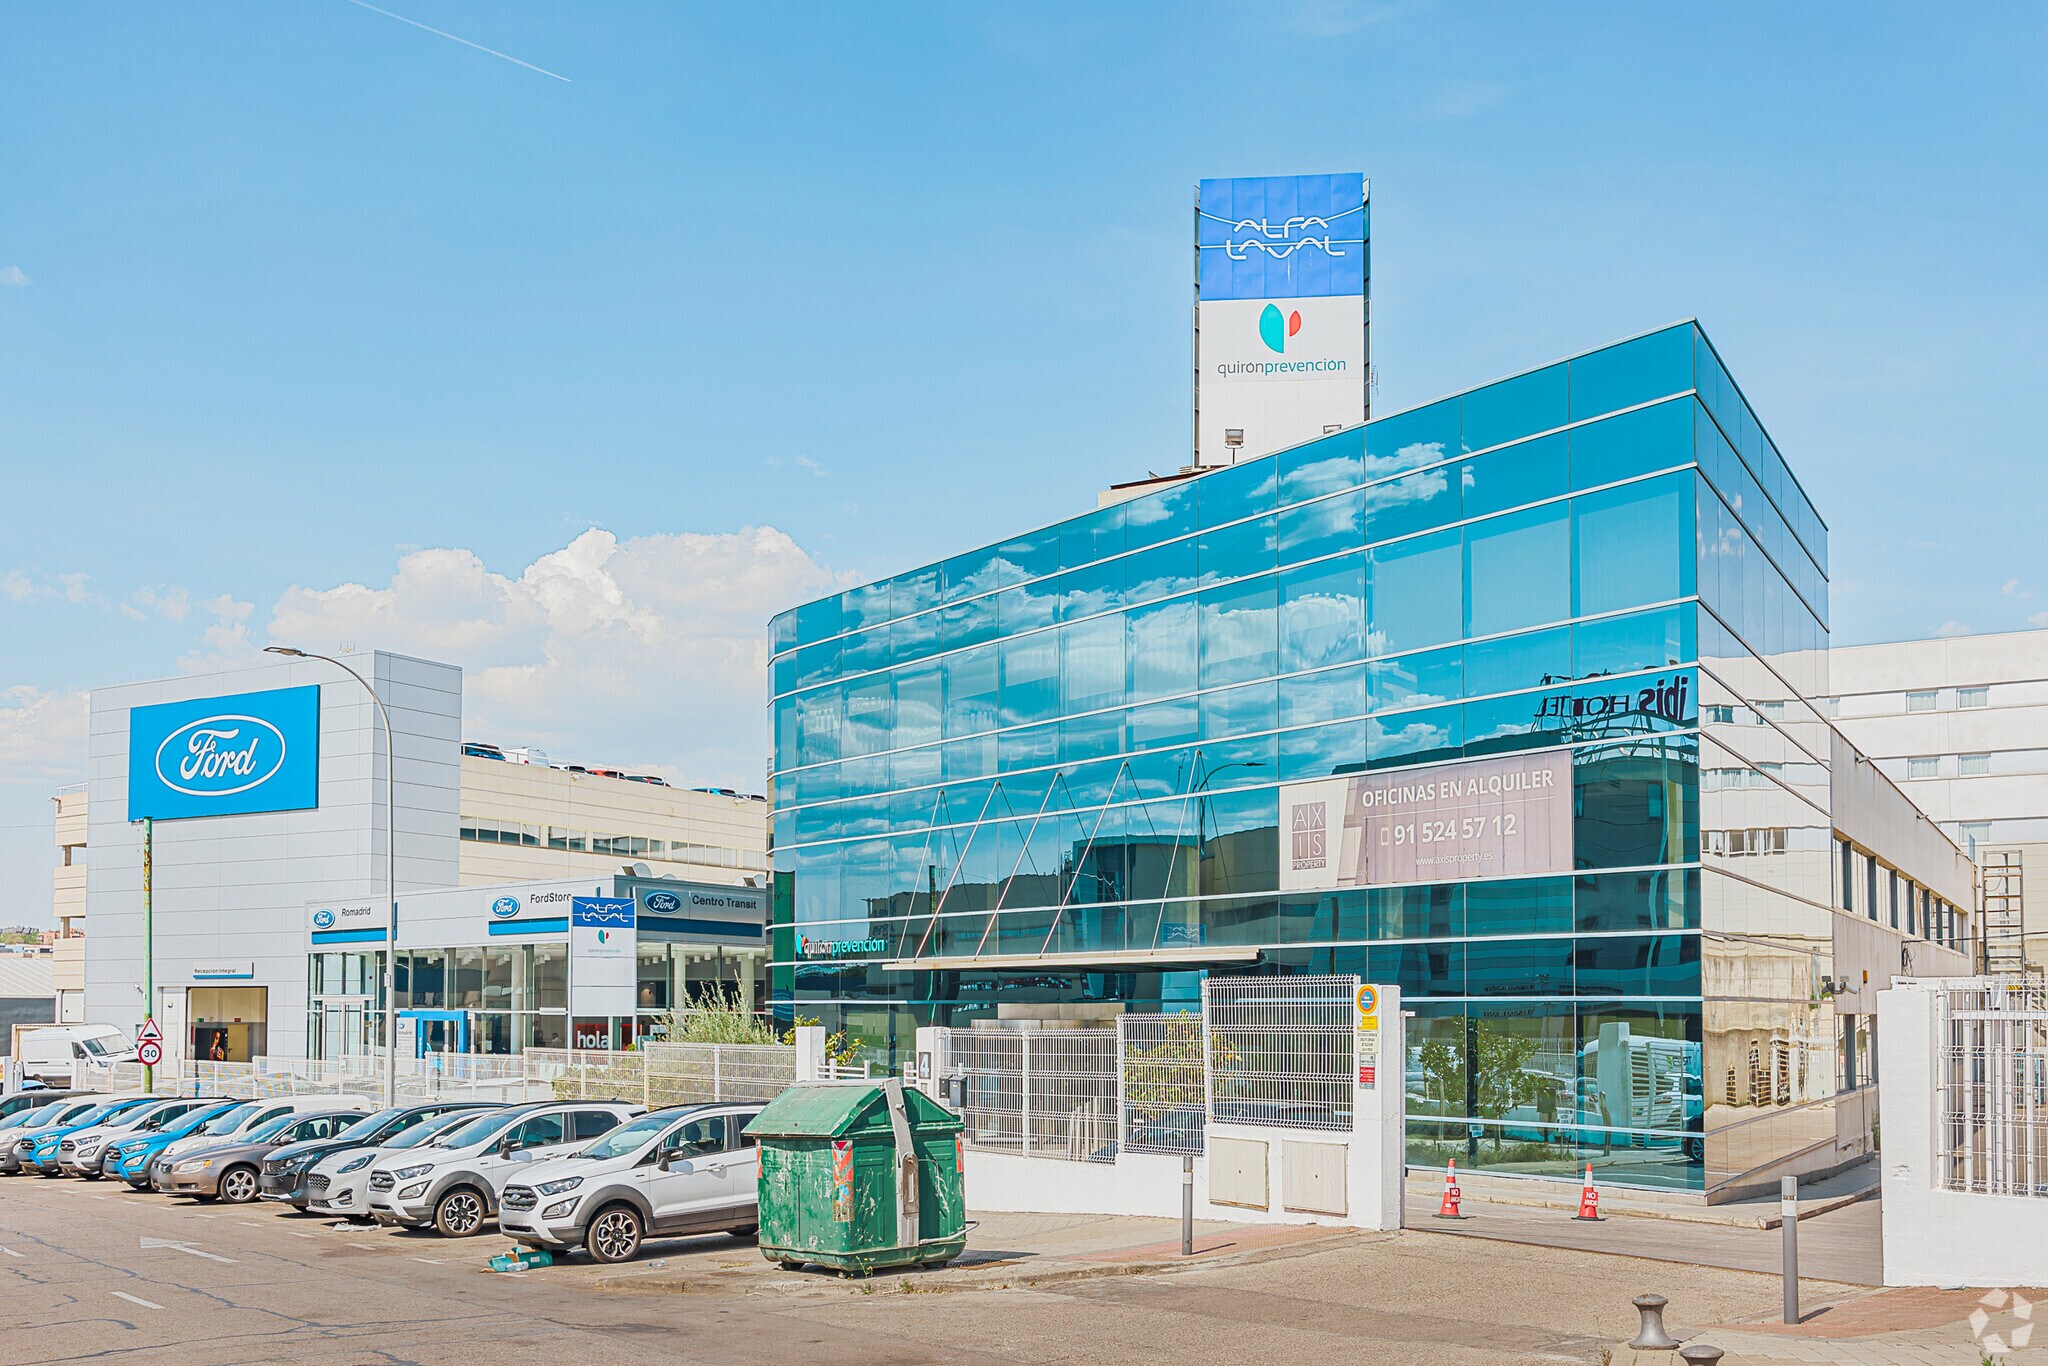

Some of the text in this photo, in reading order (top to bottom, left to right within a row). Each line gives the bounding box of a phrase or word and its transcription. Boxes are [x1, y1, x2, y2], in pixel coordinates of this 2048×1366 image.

[1234, 216, 1328, 239] ALFA
[1226, 236, 1345, 260] LAVAL
[1217, 358, 1346, 378] quirónprevención
[180, 728, 259, 780] Ford
[1362, 769, 1554, 808] OFICINAS EN ALQUILER
[1394, 813, 1517, 846] 91 524 57 12
[1293, 860, 1326, 869] PROPERTY
[1415, 852, 1493, 866] www.axisproperty.es
[530, 893, 571, 904] FordStore
[653, 895, 676, 910] Ford
[692, 895, 757, 910] Centro Transit
[341, 907, 371, 917] Romadrid
[496, 899, 513, 913] Ford
[586, 903, 622, 913] ALFA
[316, 911, 330, 924] Ford
[582, 912, 628, 922] LAVAL
[804, 937, 885, 959] quirónprevención
[577, 1030, 609, 1049] hola
[144, 1049, 157, 1058] 30
[920, 1054, 930, 1078] 4
[1450, 1188, 1459, 1196] NO
[1585, 1191, 1596, 1200] NO
